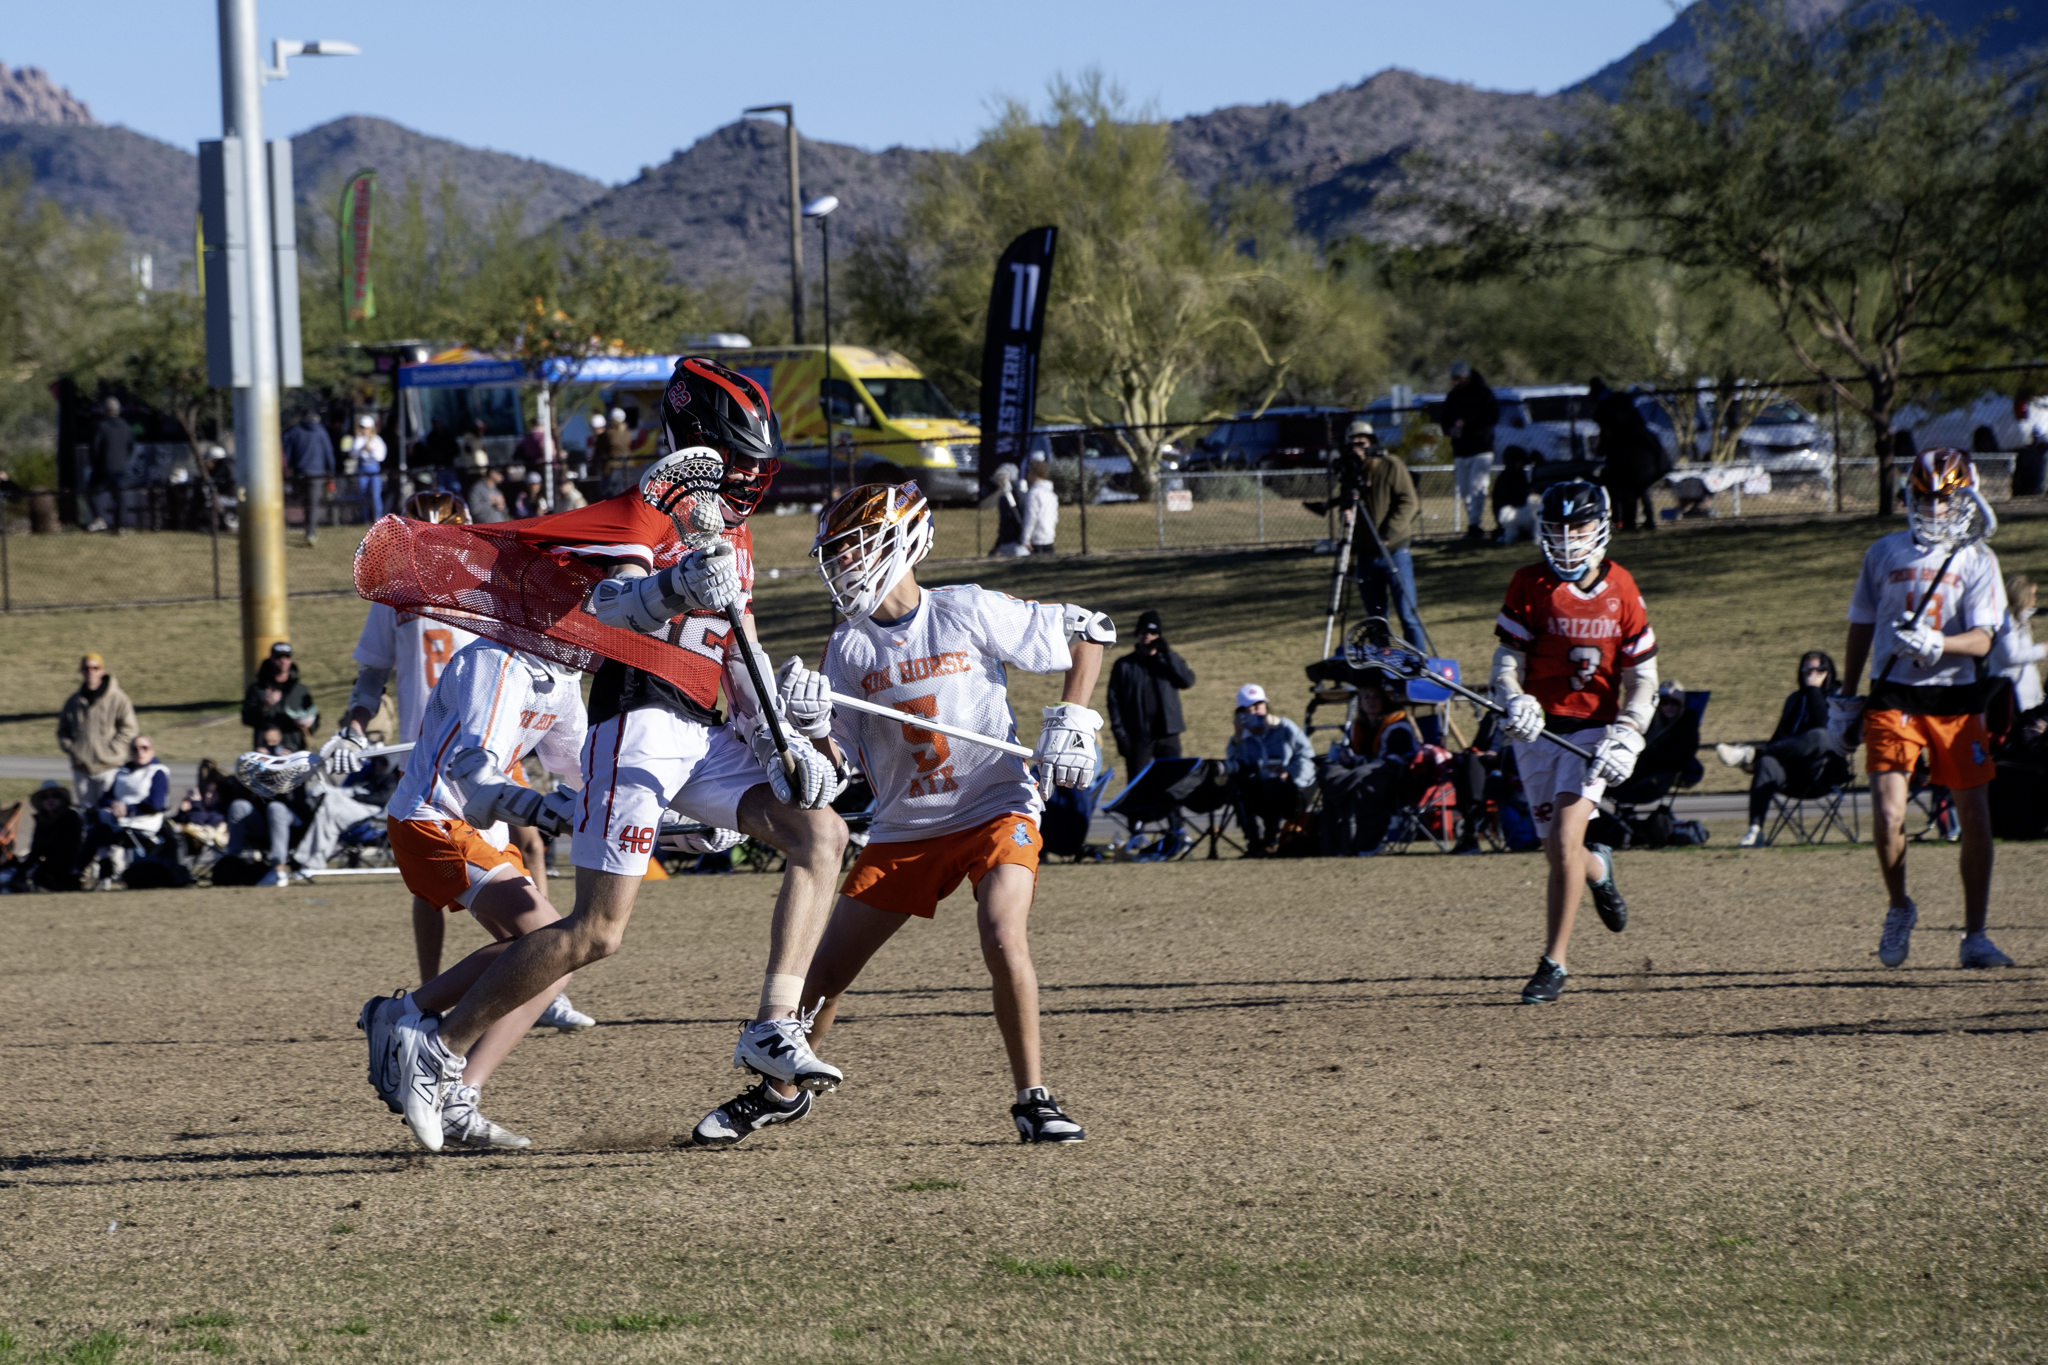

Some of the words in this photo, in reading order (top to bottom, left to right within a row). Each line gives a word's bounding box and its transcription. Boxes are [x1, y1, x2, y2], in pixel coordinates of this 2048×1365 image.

[667, 380, 693, 414] 22
[996, 344, 1021, 454] WESTERN
[422, 628, 455, 689] 8
[897, 650, 971, 685] HORSE
[1568, 644, 1602, 692] 3
[892, 694, 950, 773] 5
[909, 764, 959, 799] ATX
